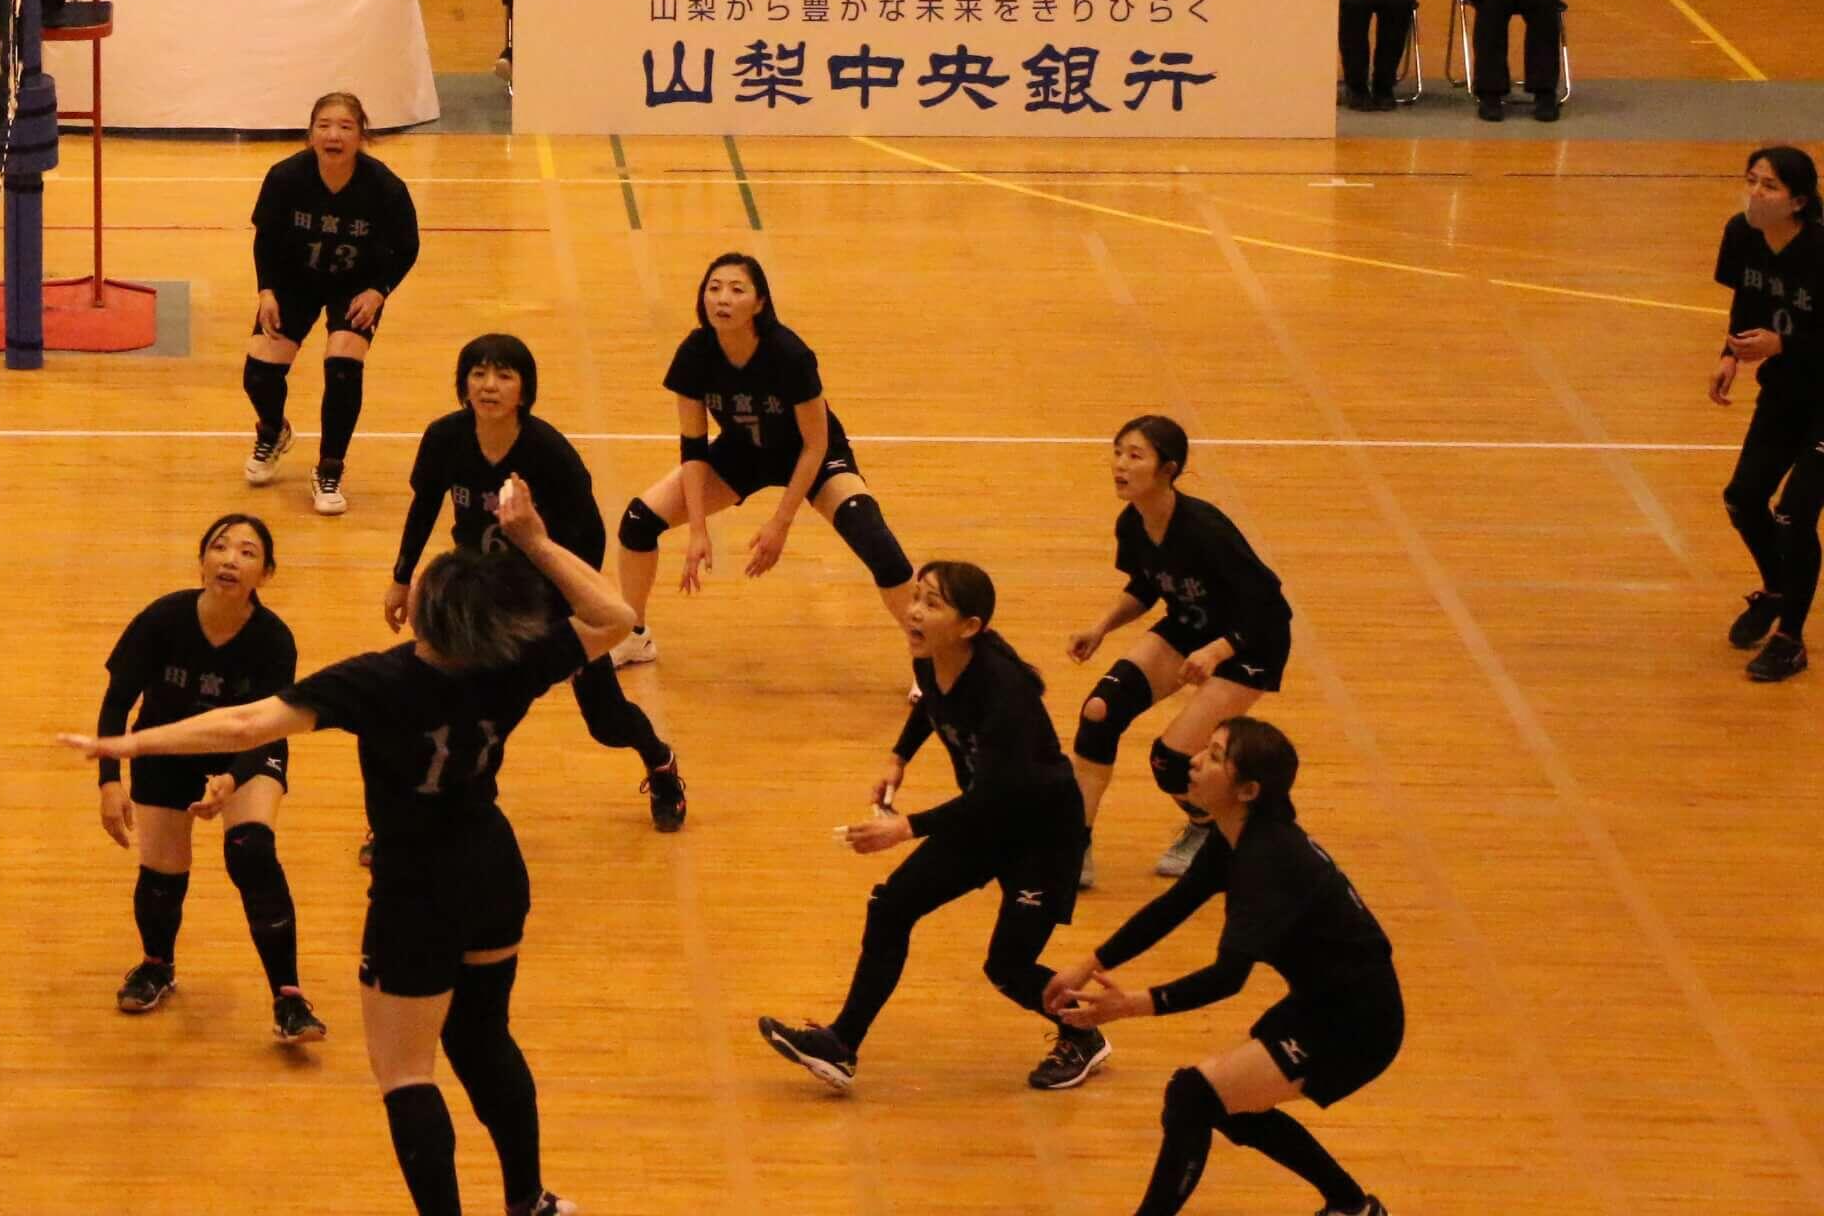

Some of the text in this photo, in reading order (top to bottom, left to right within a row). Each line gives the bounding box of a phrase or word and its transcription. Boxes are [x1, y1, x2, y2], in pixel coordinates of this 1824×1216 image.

[641, 38, 1218, 116] 山梨中央銀行
[305, 241, 360, 273] 13
[732, 414, 764, 448] 7
